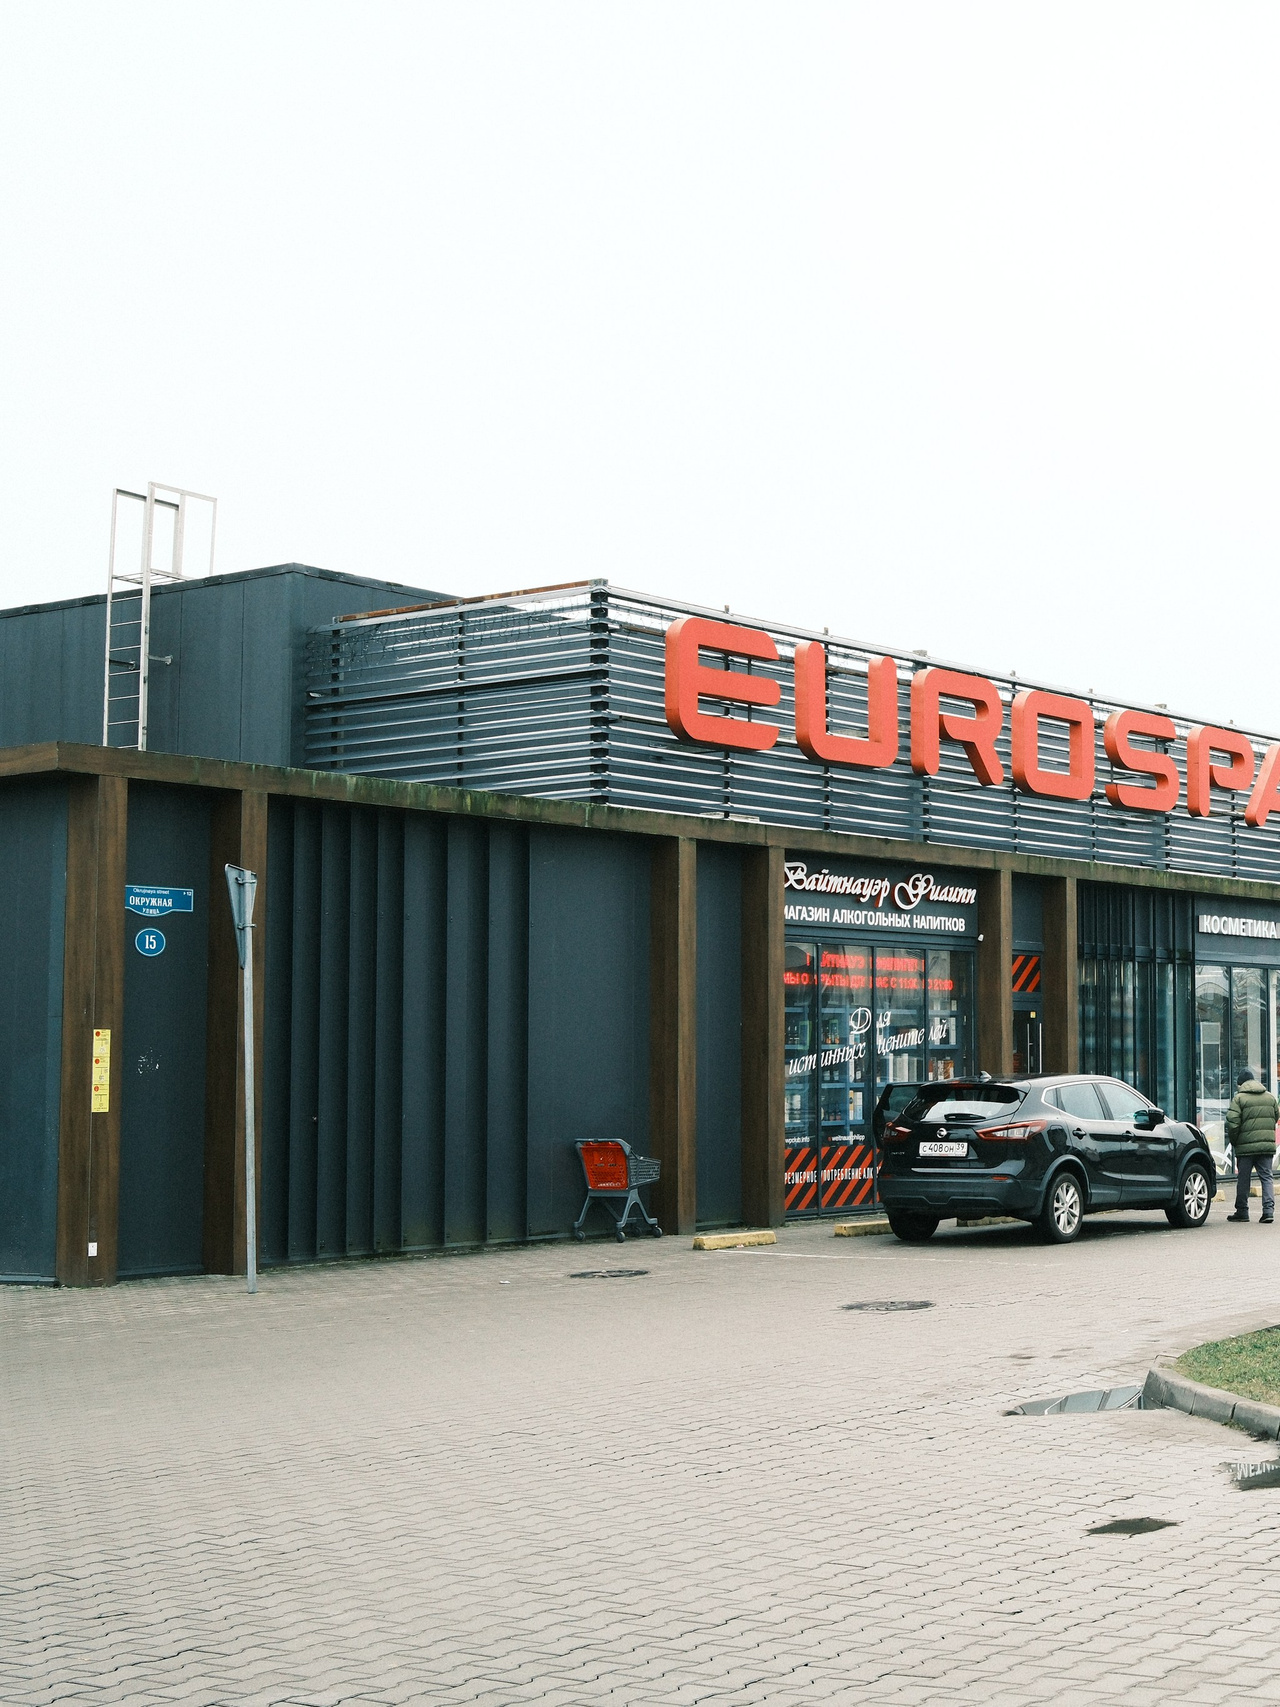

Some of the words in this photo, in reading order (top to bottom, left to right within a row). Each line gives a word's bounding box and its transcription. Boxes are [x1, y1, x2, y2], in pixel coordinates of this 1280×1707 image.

[129, 895, 173, 907] ОКРУЖНАЯ
[894, 874, 977, 910] Филипп
[833, 908, 911, 928] АЛКОГОЛЬНЫХ
[913, 915, 966, 932] НАПИТКОВ
[1199, 914, 1276, 939] КОСМЕТИКА
[145, 934, 157, 950] 15
[784, 1170, 818, 1185] РЕЗМЕРНОЕ
